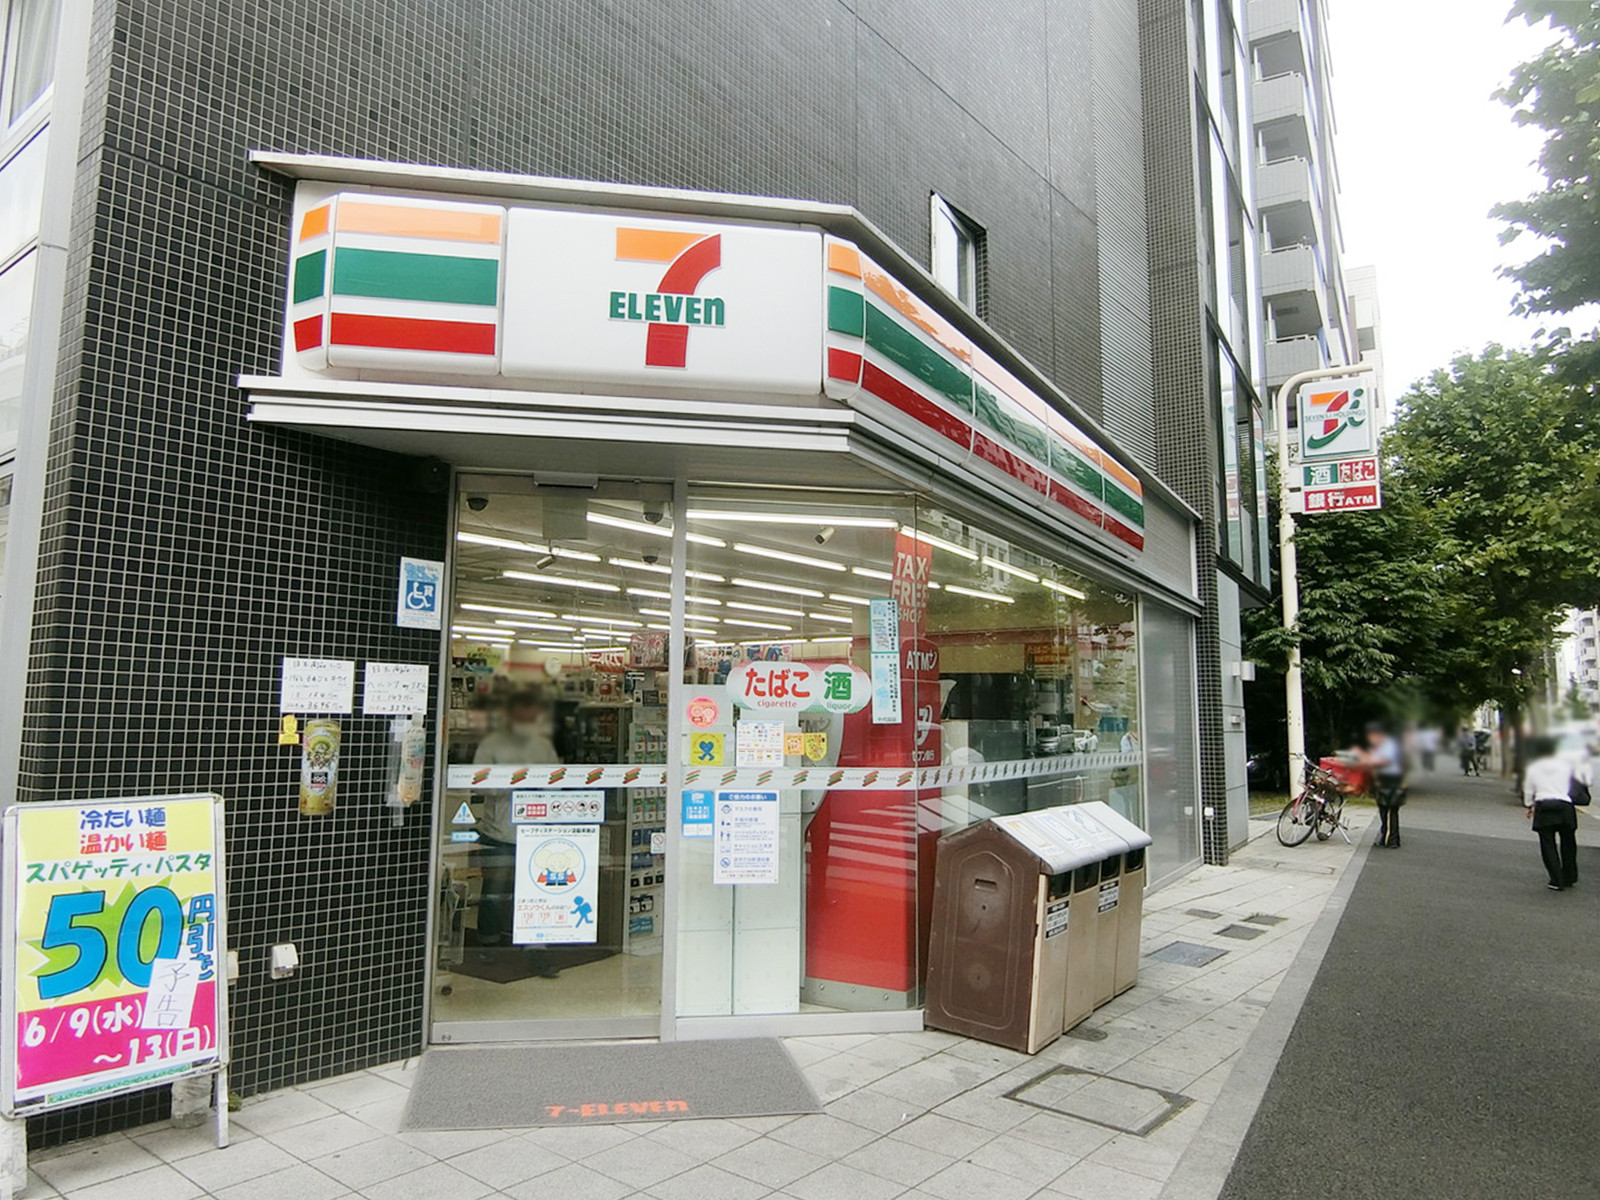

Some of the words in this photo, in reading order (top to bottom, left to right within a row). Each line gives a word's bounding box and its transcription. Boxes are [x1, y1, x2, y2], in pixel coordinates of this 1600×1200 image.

[615, 227, 721, 368] 7
[1310, 466, 1331, 485] 酒
[1341, 462, 1375, 481] たばこ
[896, 551, 927, 580] TAX
[745, 668, 811, 698] たばこ
[824, 671, 852, 700] 酒
[757, 700, 798, 711] cigarette
[827, 702, 853, 711] liquor
[80, 807, 166, 830] 冷たい麺
[80, 830, 168, 855] 温かい麺
[26, 853, 212, 884] スパゲッティ・パスタ
[37, 885, 184, 1000] 50
[187, 894, 216, 981] 円引き
[153, 962, 190, 1027] 予告
